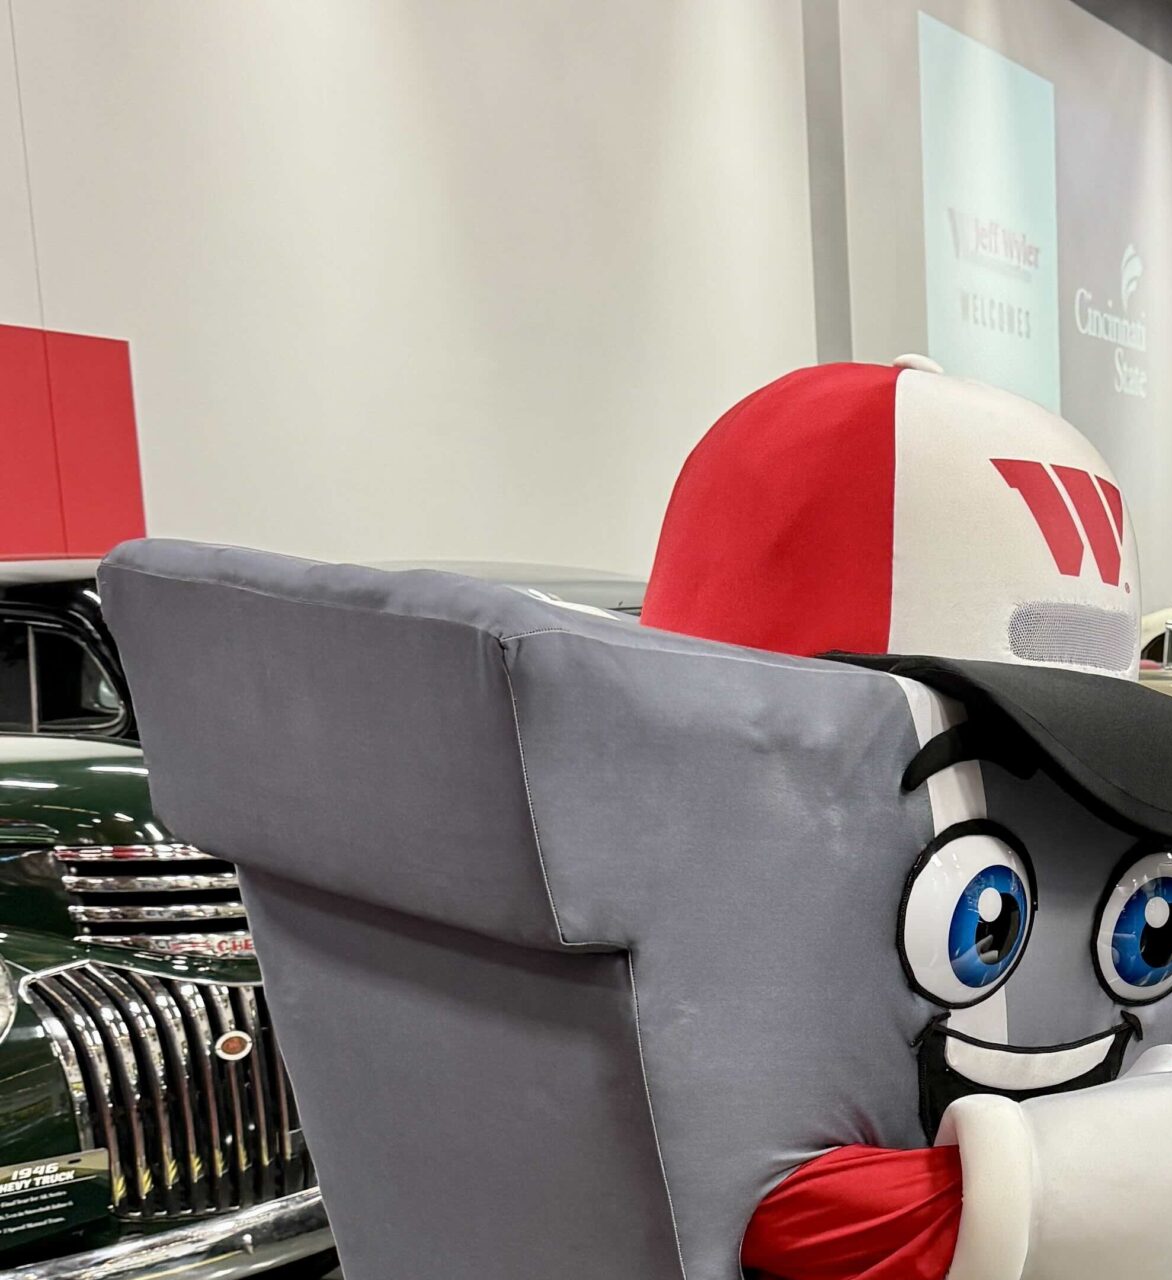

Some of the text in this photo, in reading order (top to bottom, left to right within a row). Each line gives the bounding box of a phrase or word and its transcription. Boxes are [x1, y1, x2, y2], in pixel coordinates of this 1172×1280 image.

[960, 290, 1032, 340] WELCOMES
[1074, 288, 1147, 353] Cincinnati
[1114, 346, 1148, 399] State
[989, 458, 1124, 587] W
[216, 938, 254, 953] CHE
[0, 1169, 76, 1195] HEVY TRUCK
[11, 1162, 60, 1181] 1946
